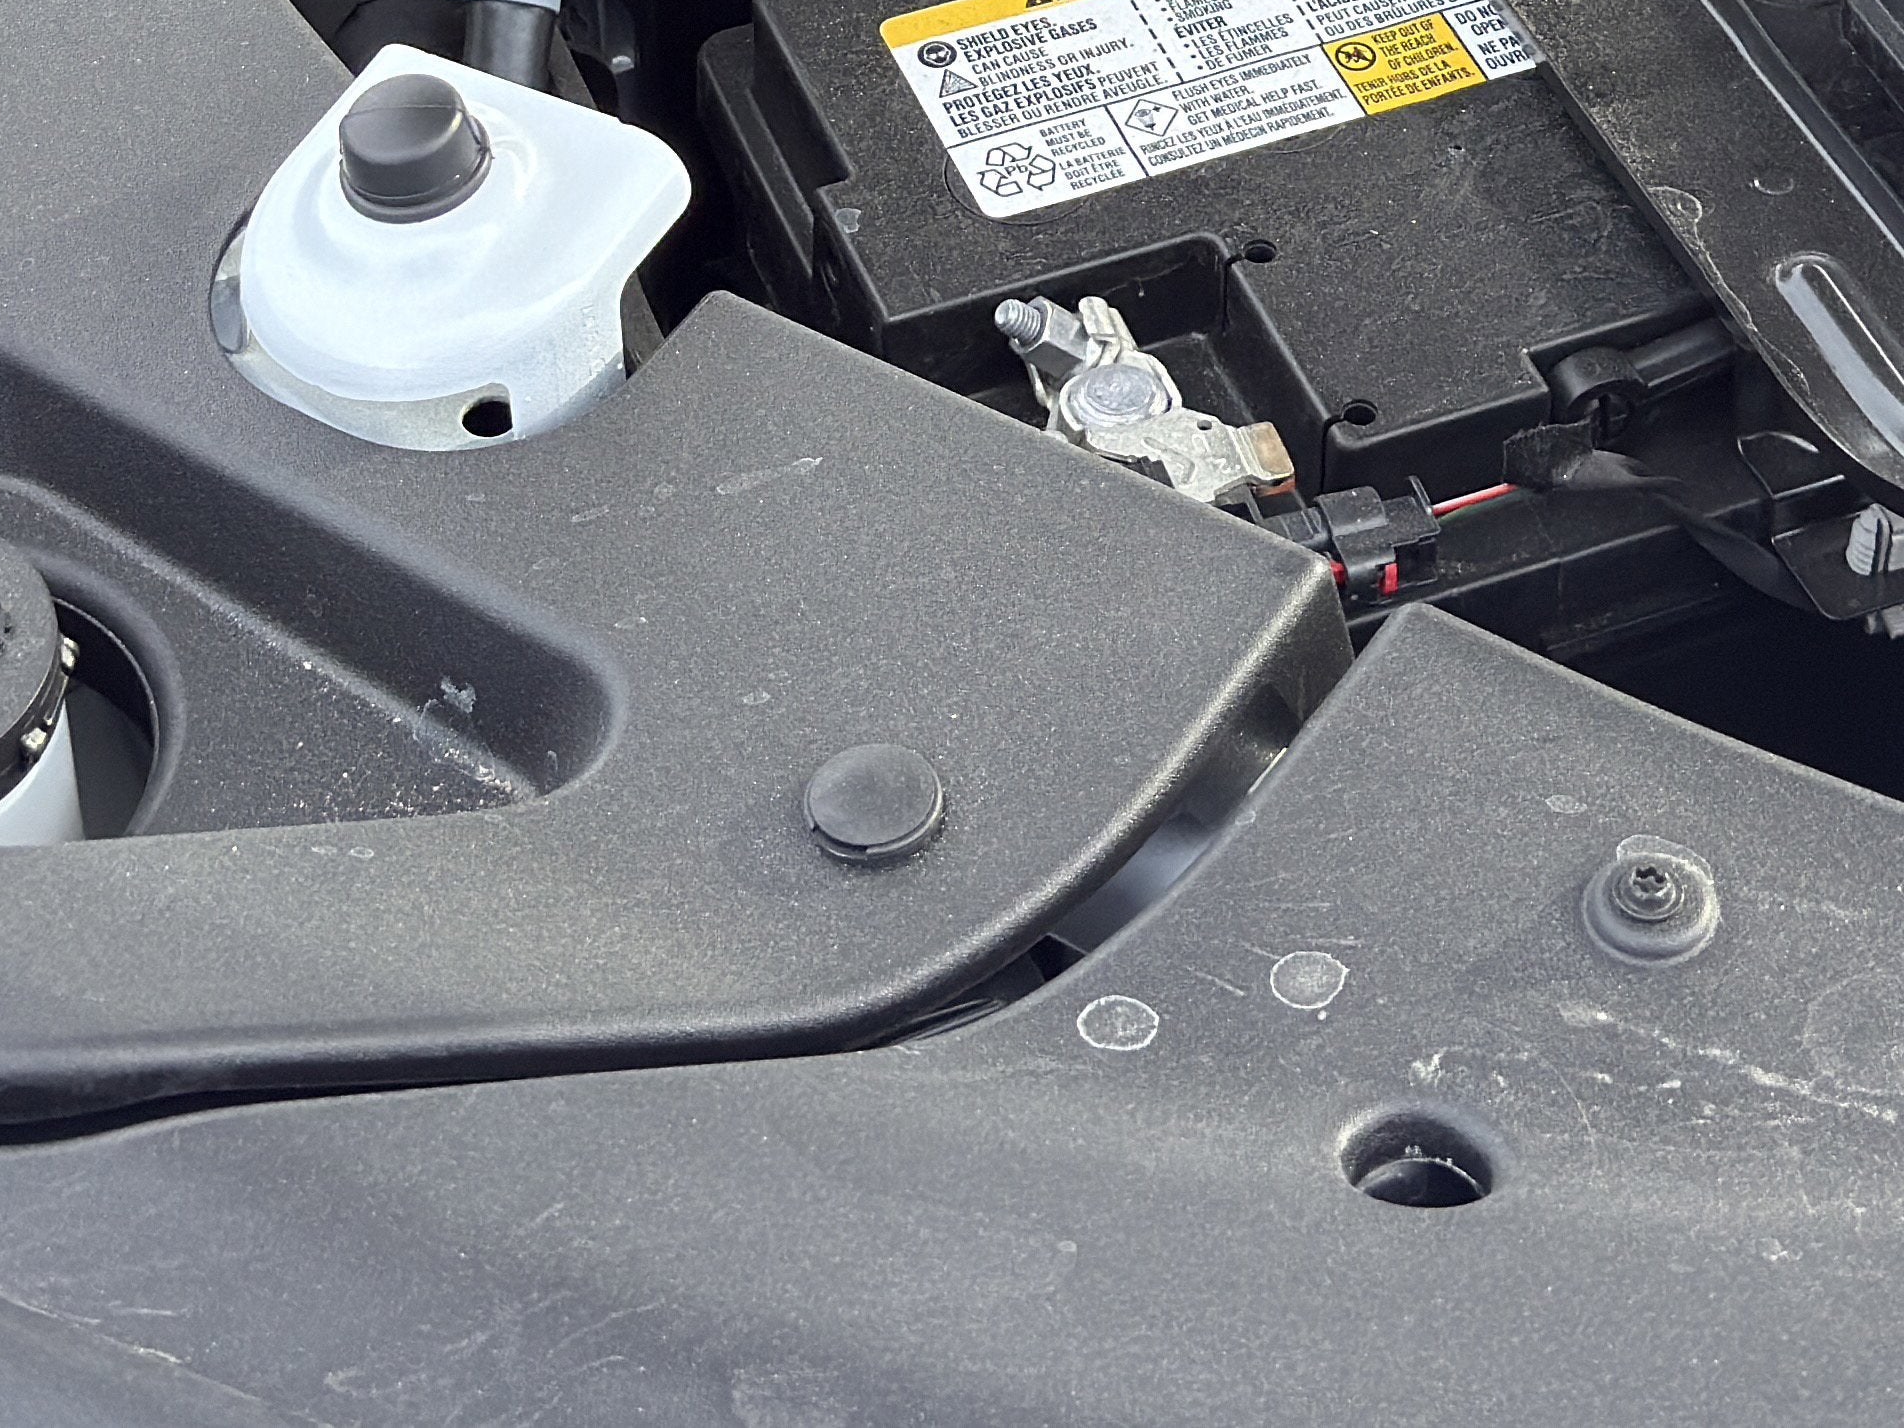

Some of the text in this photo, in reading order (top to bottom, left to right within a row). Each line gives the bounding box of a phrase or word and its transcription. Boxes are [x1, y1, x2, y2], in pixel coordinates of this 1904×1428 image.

[1170, 11, 1228, 39] ÉVITER
[1190, 9, 1295, 50] LES ÉTINCELLES
[1314, 6, 1353, 26] PEUT
[1322, 22, 1348, 38] OU
[1344, 15, 1374, 32] DES
[1453, 8, 1481, 25] DO
[954, 13, 1058, 52] SHIELD EYES.
[962, 16, 1099, 64] EXPLOSIVE GASES
[1196, 25, 1290, 60] LES FLAMMES
[1369, 18, 1436, 45] KEEP OUT OF
[1378, 32, 1437, 57] THE REACH
[1476, 33, 1523, 56] NE PA
[970, 45, 1050, 76] CAN CAUSE
[976, 36, 1135, 88] BLINDNESS OR INJURY.
[1203, 42, 1273, 71] DE FUMER
[939, 60, 1102, 115] PROTÉGEZ LES YEUX.
[1170, 52, 1313, 101] FLUSH EYES IMMEDIATELY
[1353, 58, 1451, 94] TENIR HORS DE LA
[1402, 79, 1423, 94] DE
[948, 59, 1162, 128] LES GAZ EXPLOSIFS PEUVENT
[956, 71, 1169, 139] BLESSER OU RENDRE AVEUGLE.
[1178, 83, 1255, 113] WITH WATER.
[1185, 77, 1324, 125] GET MEDICAL HELP FAST.
[1038, 116, 1088, 138] BATTERY
[1044, 127, 1092, 148] MUST BE
[1195, 121, 1225, 138] YEUX
[1049, 134, 1107, 158] RECYCLED
[1057, 144, 1126, 171] LA BATTERIE
[1146, 141, 1207, 167] CONSULTEZ
[1203, 136, 1222, 151] UN
[1003, 158, 1030, 177] Pb
[1068, 165, 1126, 190] RECYCLÉE
[1088, 155, 1121, 173] ÊTRE
